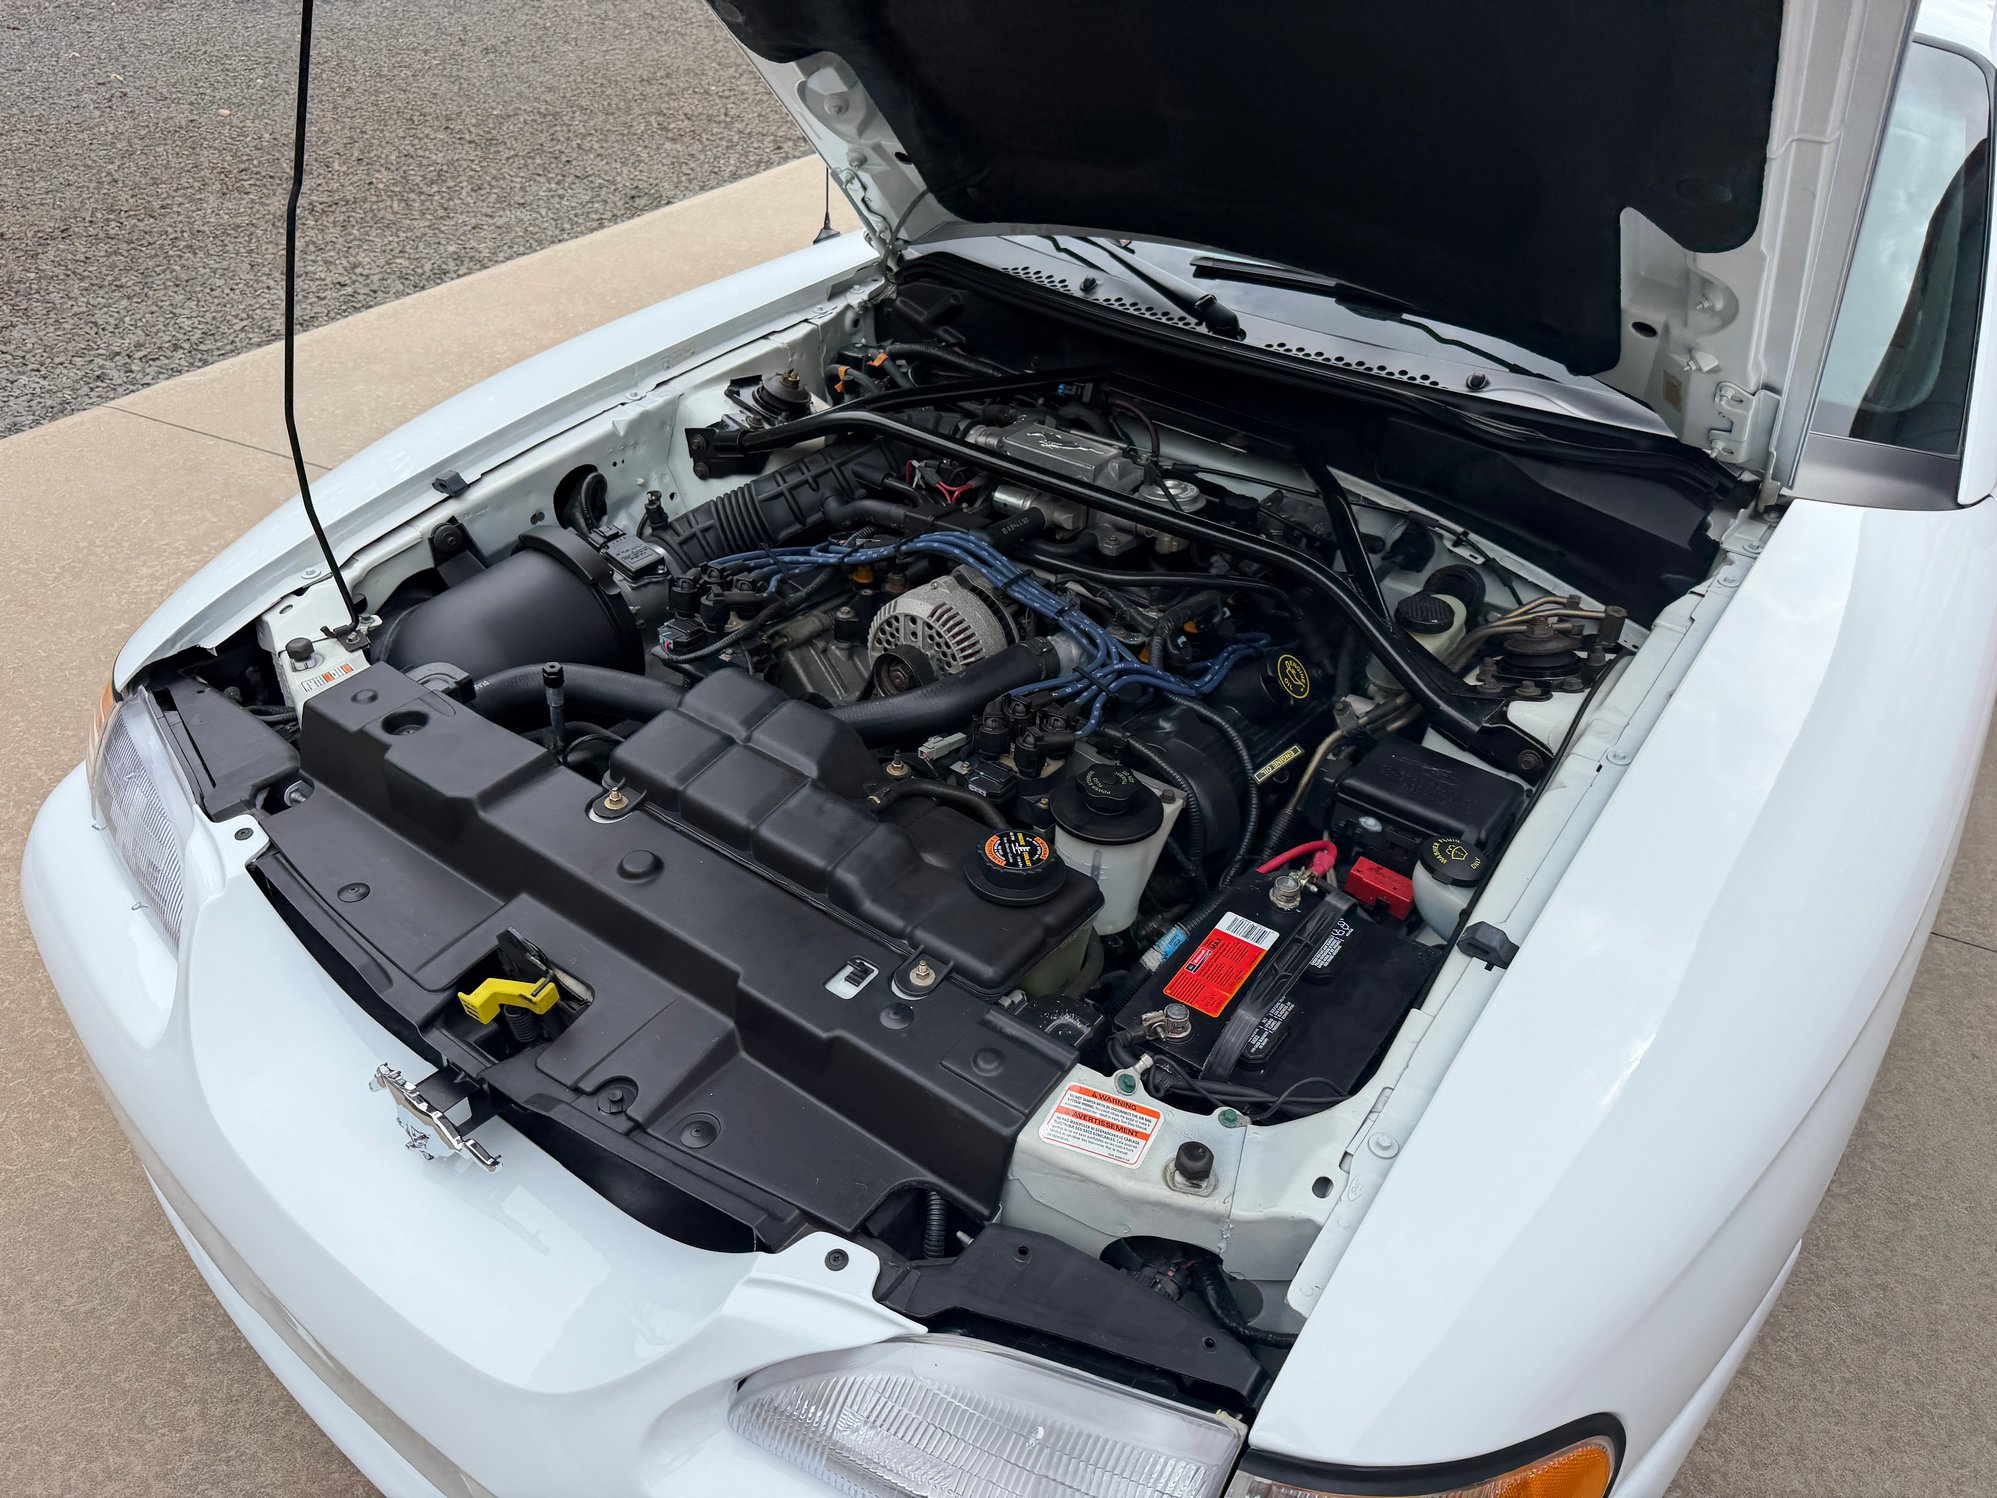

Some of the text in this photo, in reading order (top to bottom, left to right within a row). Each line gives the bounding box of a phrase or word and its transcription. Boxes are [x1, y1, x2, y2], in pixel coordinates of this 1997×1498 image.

[1289, 660, 1306, 684] ENGINE
[1284, 678, 1293, 690] OIL
[1260, 750, 1295, 775] ENGINE OIL
[1432, 842, 1448, 864] WASHER
[1470, 857, 1480, 870] ONLY
[1210, 938, 1223, 951] MAX
[1099, 1094, 1137, 1111] WARNING
[1072, 1111, 1139, 1137] AVERTISSEMENT
